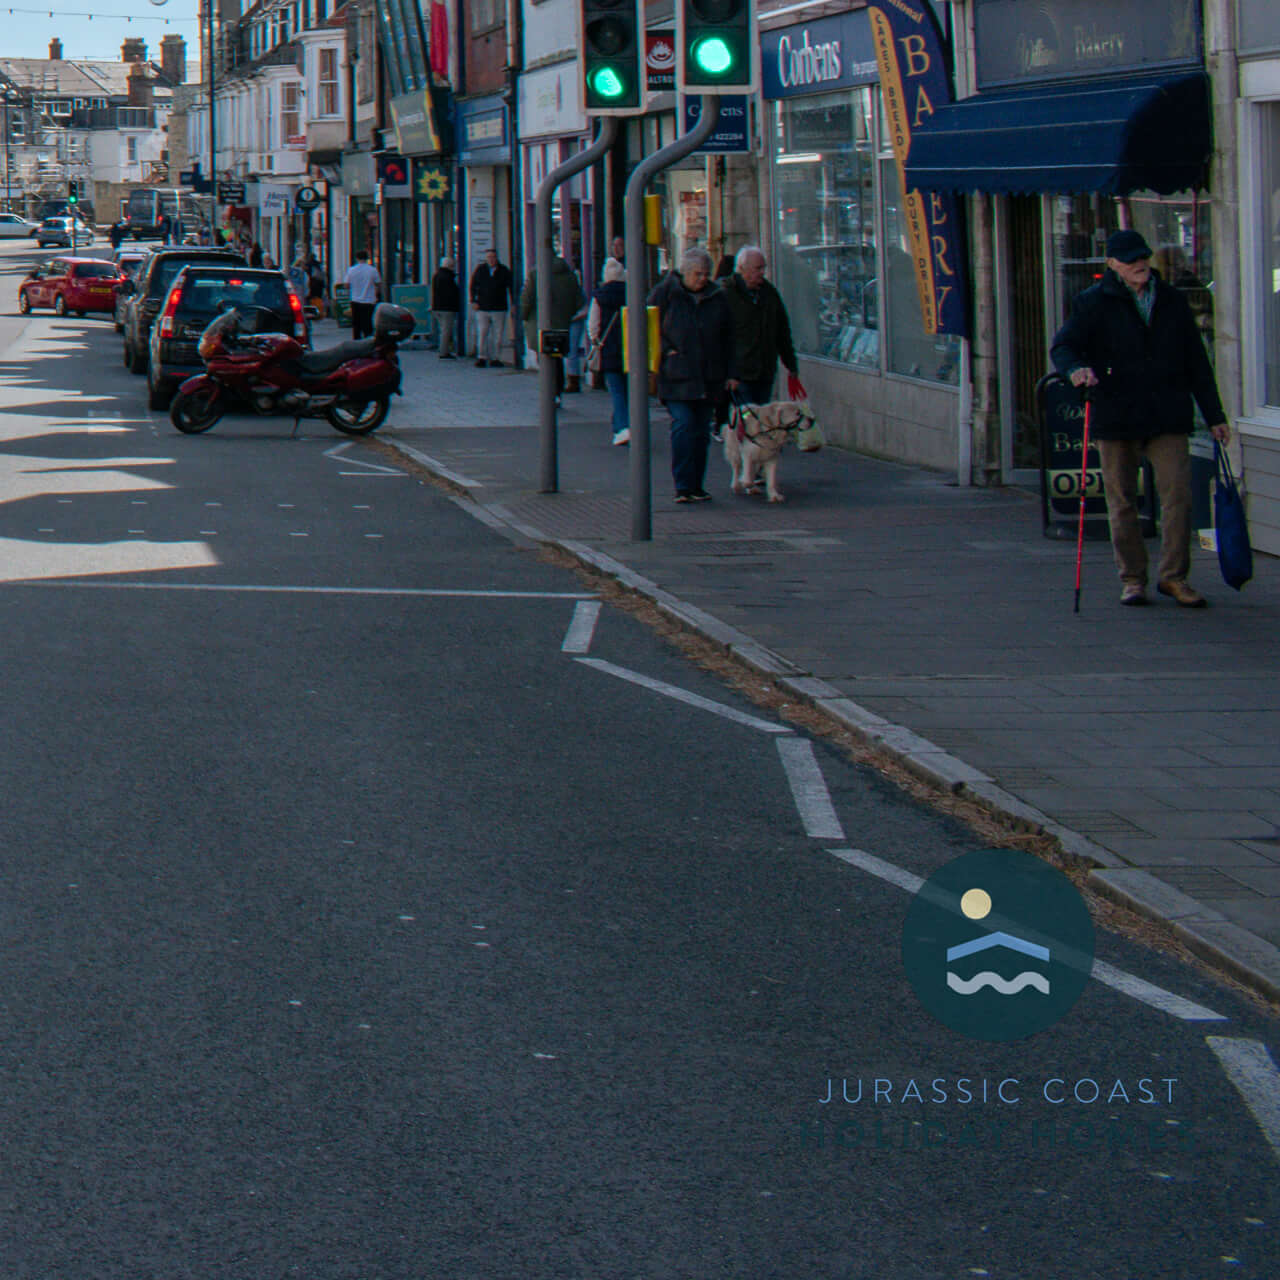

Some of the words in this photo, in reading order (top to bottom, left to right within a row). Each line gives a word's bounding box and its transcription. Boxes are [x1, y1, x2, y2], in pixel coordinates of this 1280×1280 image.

[778, 29, 841, 88] Corbens
[875, 14, 890, 73] CAKES
[888, 86, 905, 147] BREAD
[898, 34, 954, 326] BAERY
